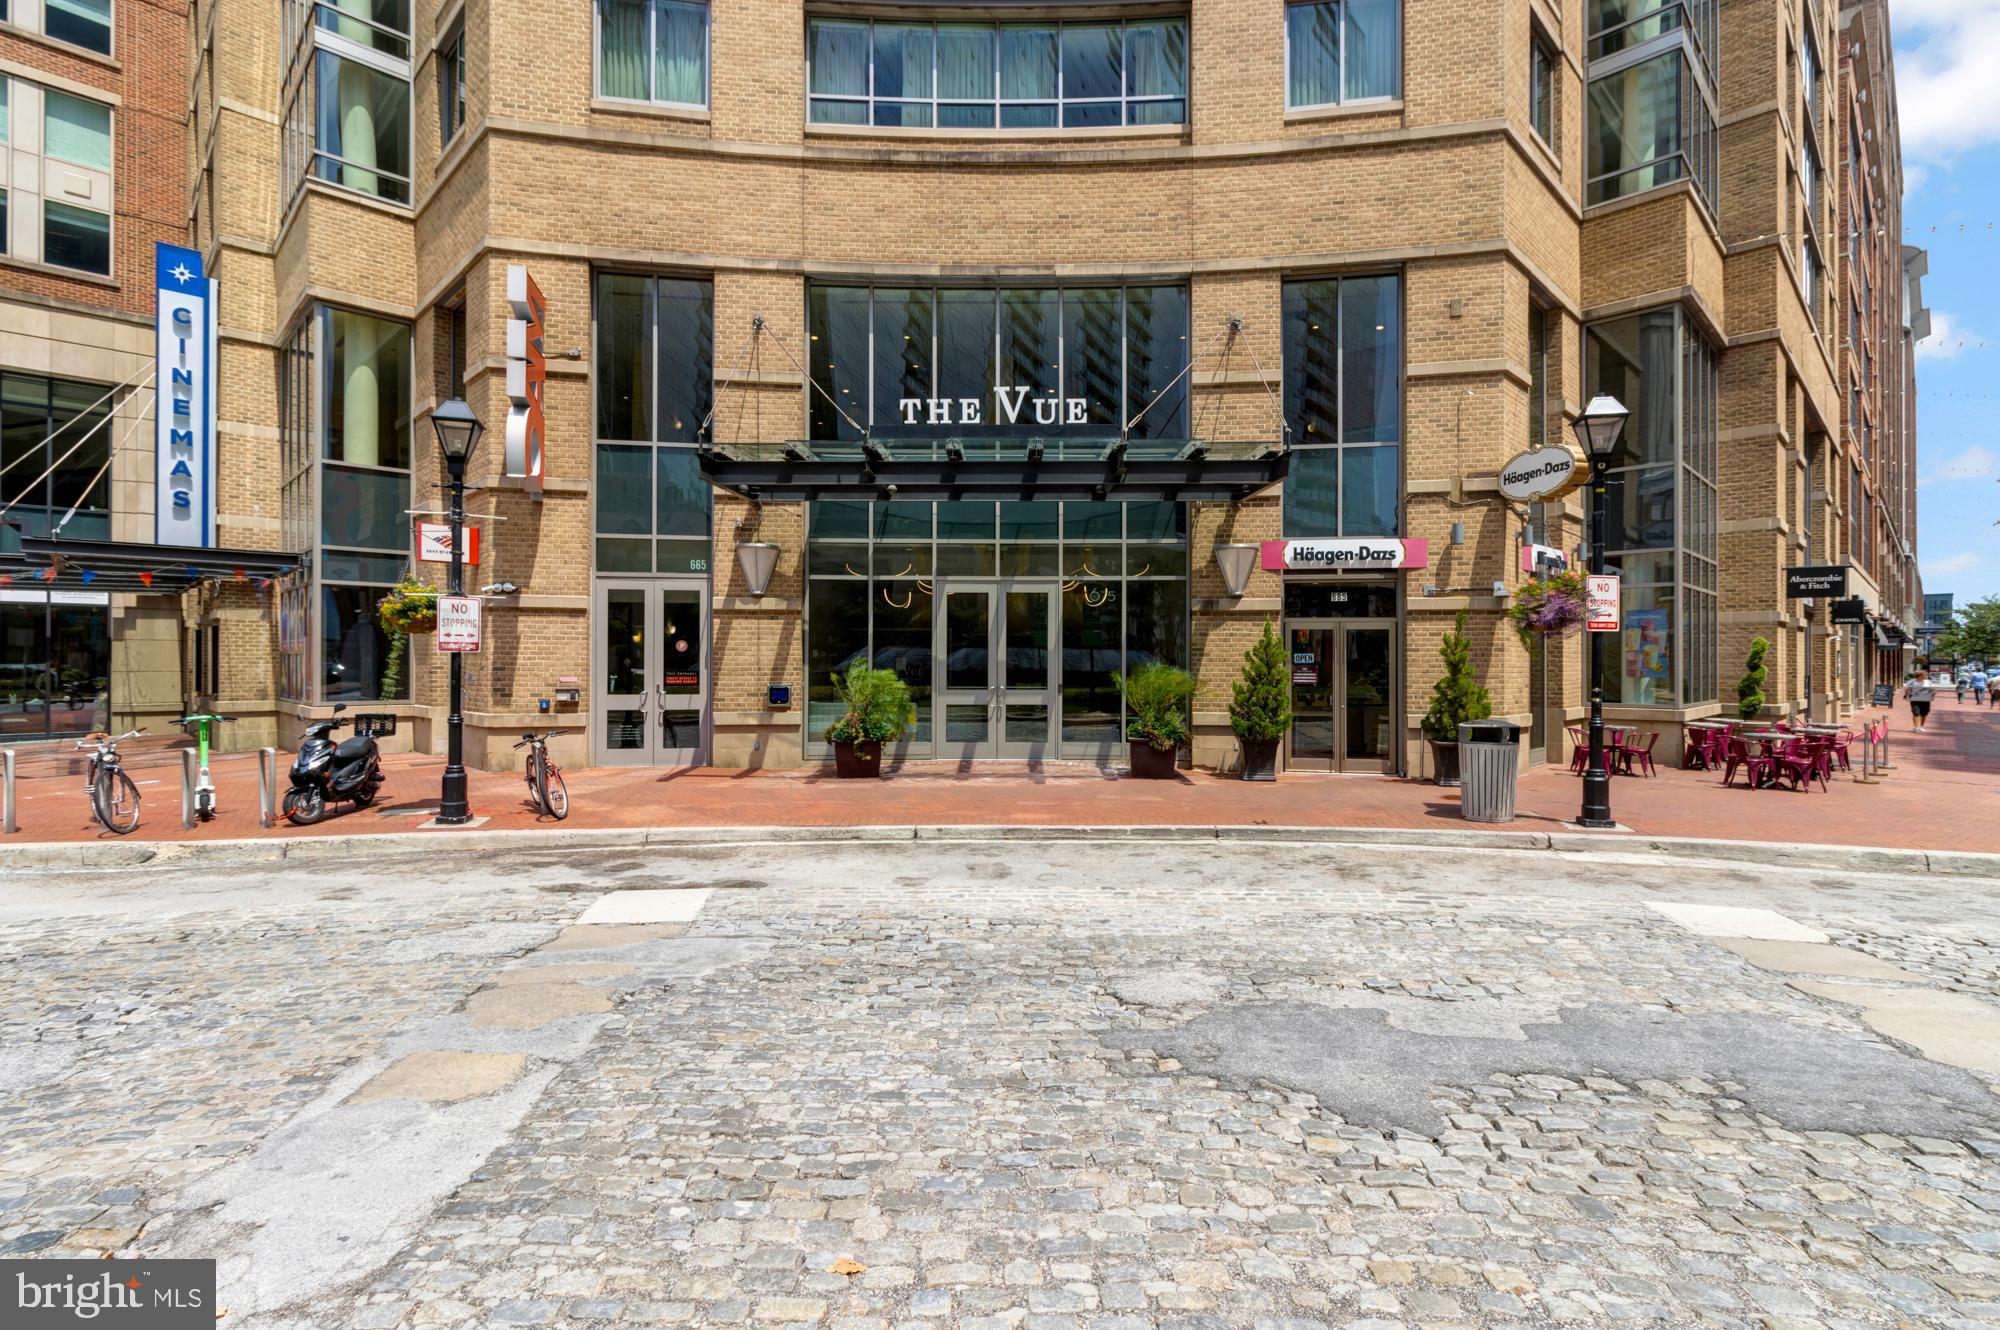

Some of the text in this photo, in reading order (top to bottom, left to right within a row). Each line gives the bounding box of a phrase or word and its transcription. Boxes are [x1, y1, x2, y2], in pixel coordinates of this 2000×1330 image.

[170, 307, 193, 509] CINEMAS
[900, 386, 1088, 425] THE VUE
[1503, 460, 1571, 486] Häagen-Dazs
[1293, 546, 1397, 565] Häagen-Dazs
[690, 559, 707, 570] 665
[1790, 574, 1843, 583] Abercrombie
[1597, 582, 1610, 593] NO
[451, 603, 468, 615] NO
[1590, 599, 1617, 608] STOPPING
[441, 617, 478, 629] STOPPING
[1296, 654, 1313, 662] OPEN
